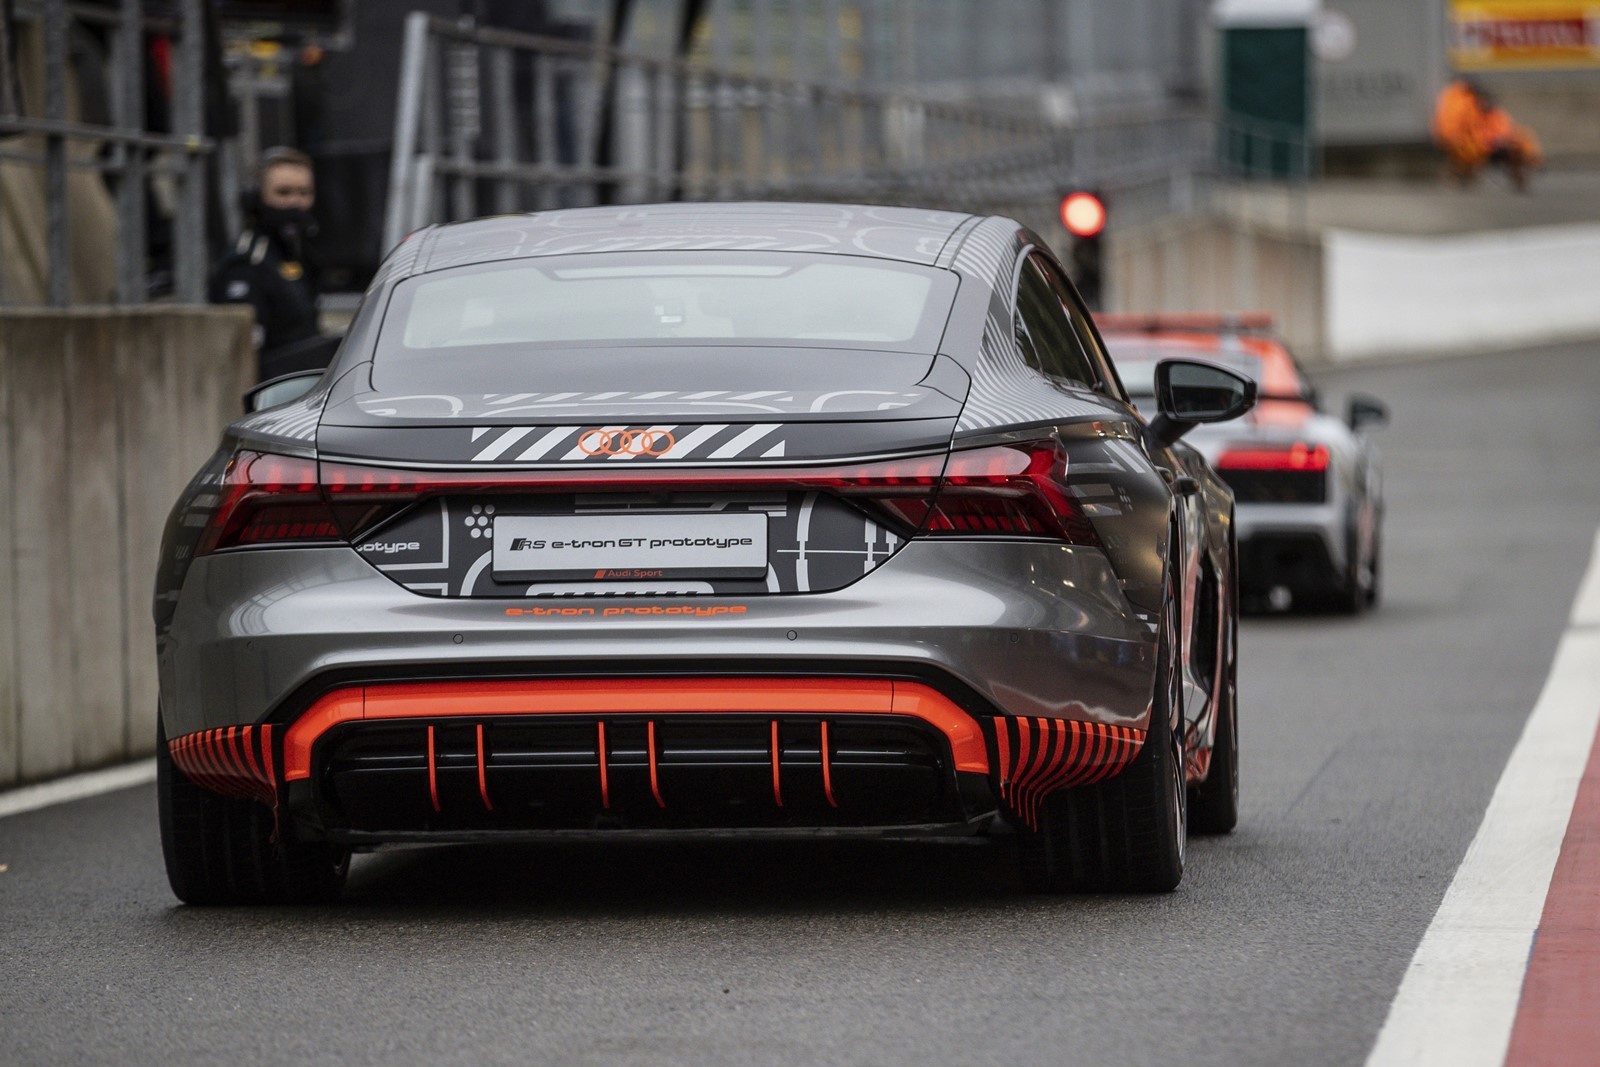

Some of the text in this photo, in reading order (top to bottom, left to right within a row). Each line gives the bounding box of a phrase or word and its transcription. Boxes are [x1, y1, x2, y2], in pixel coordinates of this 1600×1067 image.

[516, 537, 753, 551] RS e-tron GT prototype
[607, 569, 663, 579] Audi Sport
[505, 605, 747, 617] e-tron prototype
